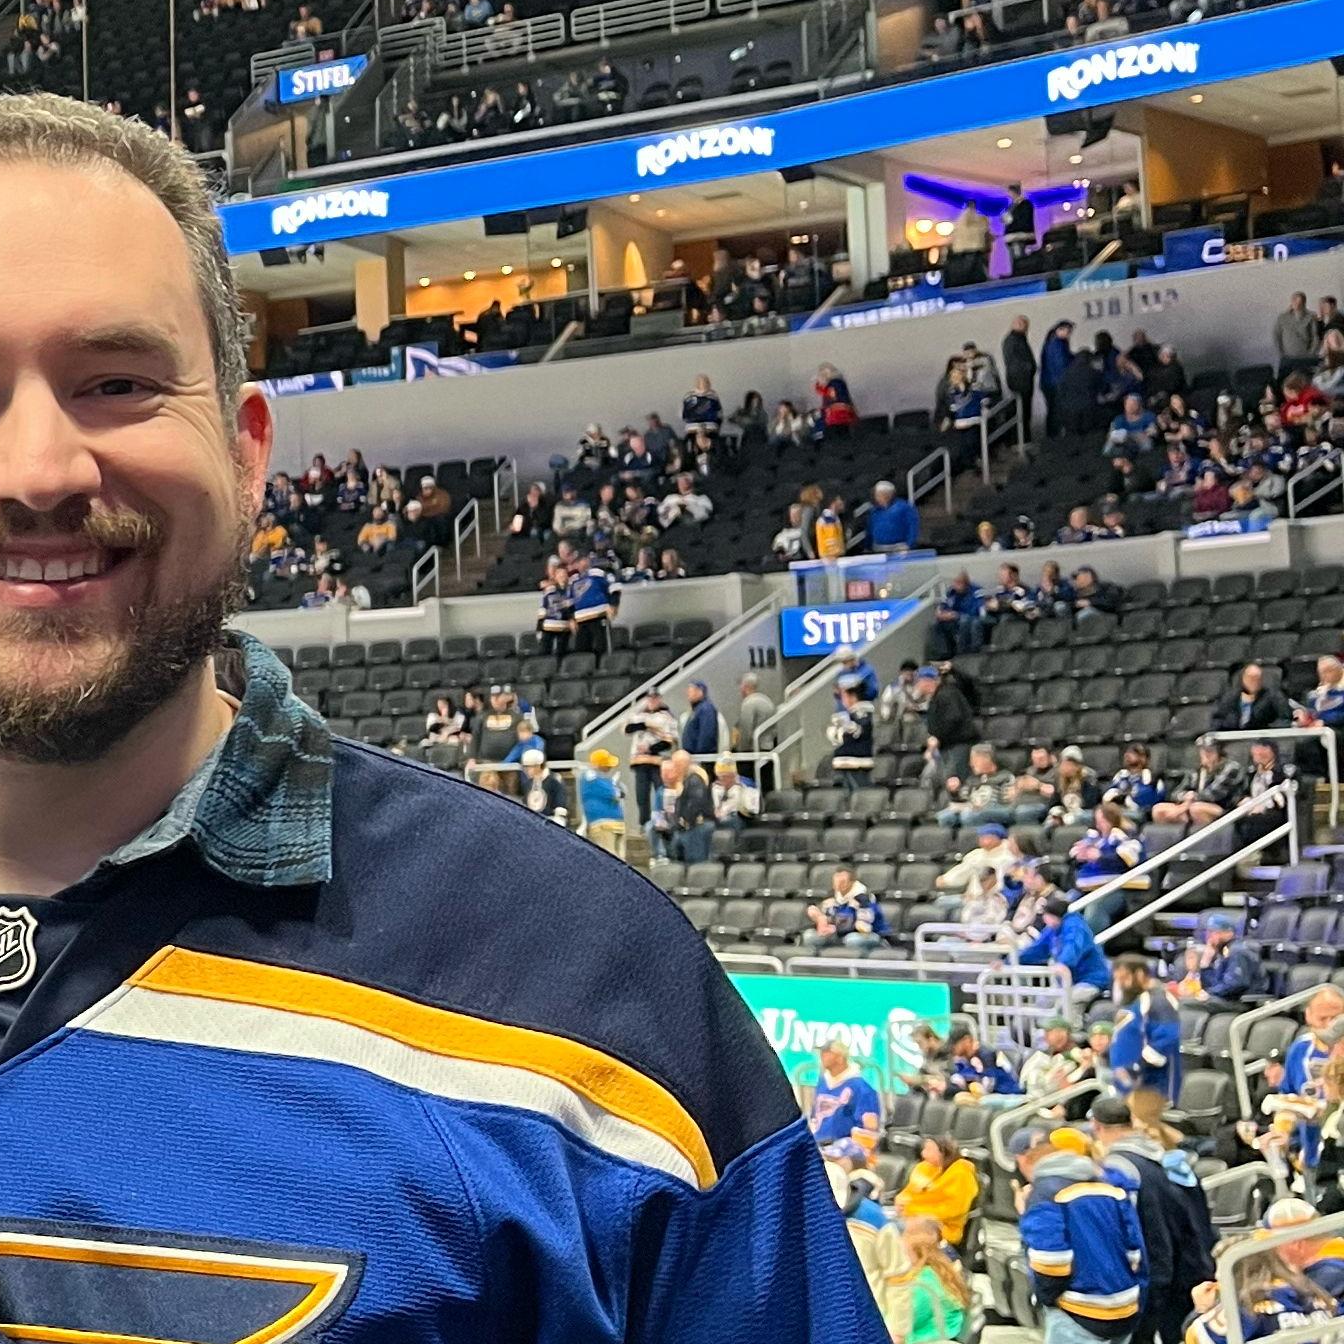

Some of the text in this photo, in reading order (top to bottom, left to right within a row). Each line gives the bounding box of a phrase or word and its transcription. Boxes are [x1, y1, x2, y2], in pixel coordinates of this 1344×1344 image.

[1047, 42, 1201, 103] RONZONI
[637, 125, 776, 178] RONZONI
[271, 189, 390, 235] RONZONI
[761, 1007, 877, 1058] UNION
